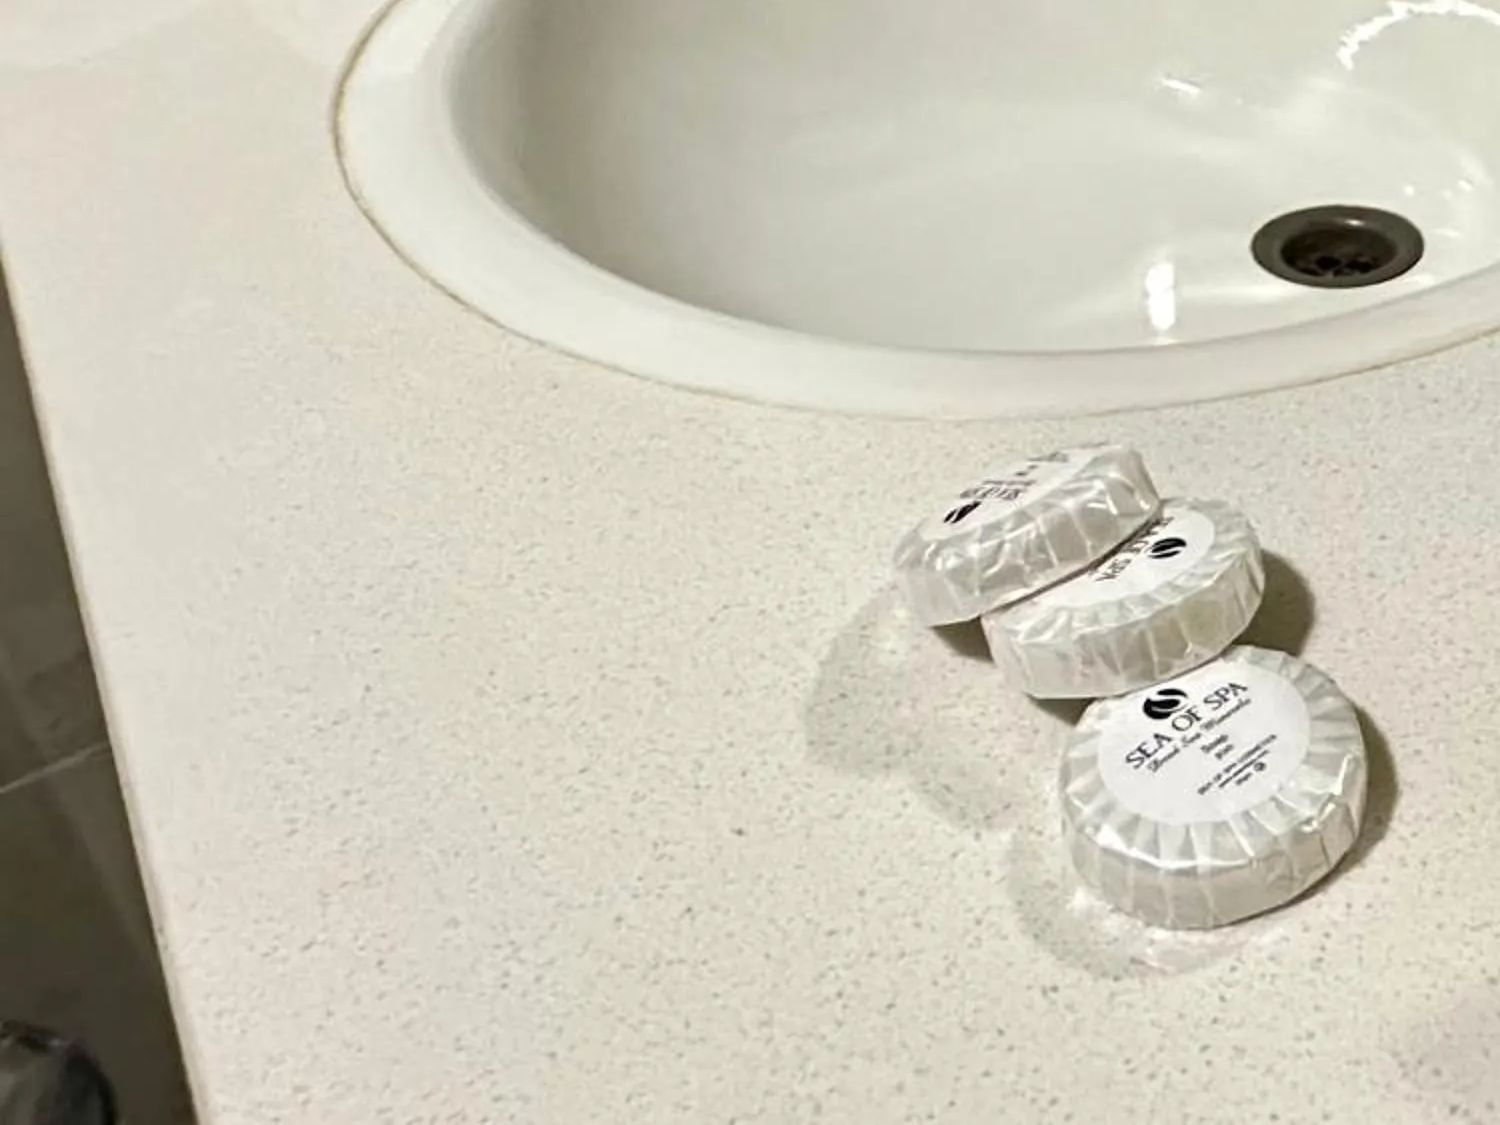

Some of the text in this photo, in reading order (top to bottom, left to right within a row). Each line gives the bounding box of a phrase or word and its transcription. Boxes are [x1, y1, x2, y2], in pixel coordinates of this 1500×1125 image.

[1125, 732, 1173, 769] SEA
[1171, 705, 1201, 732] OF
[1203, 682, 1248, 711] SPA
